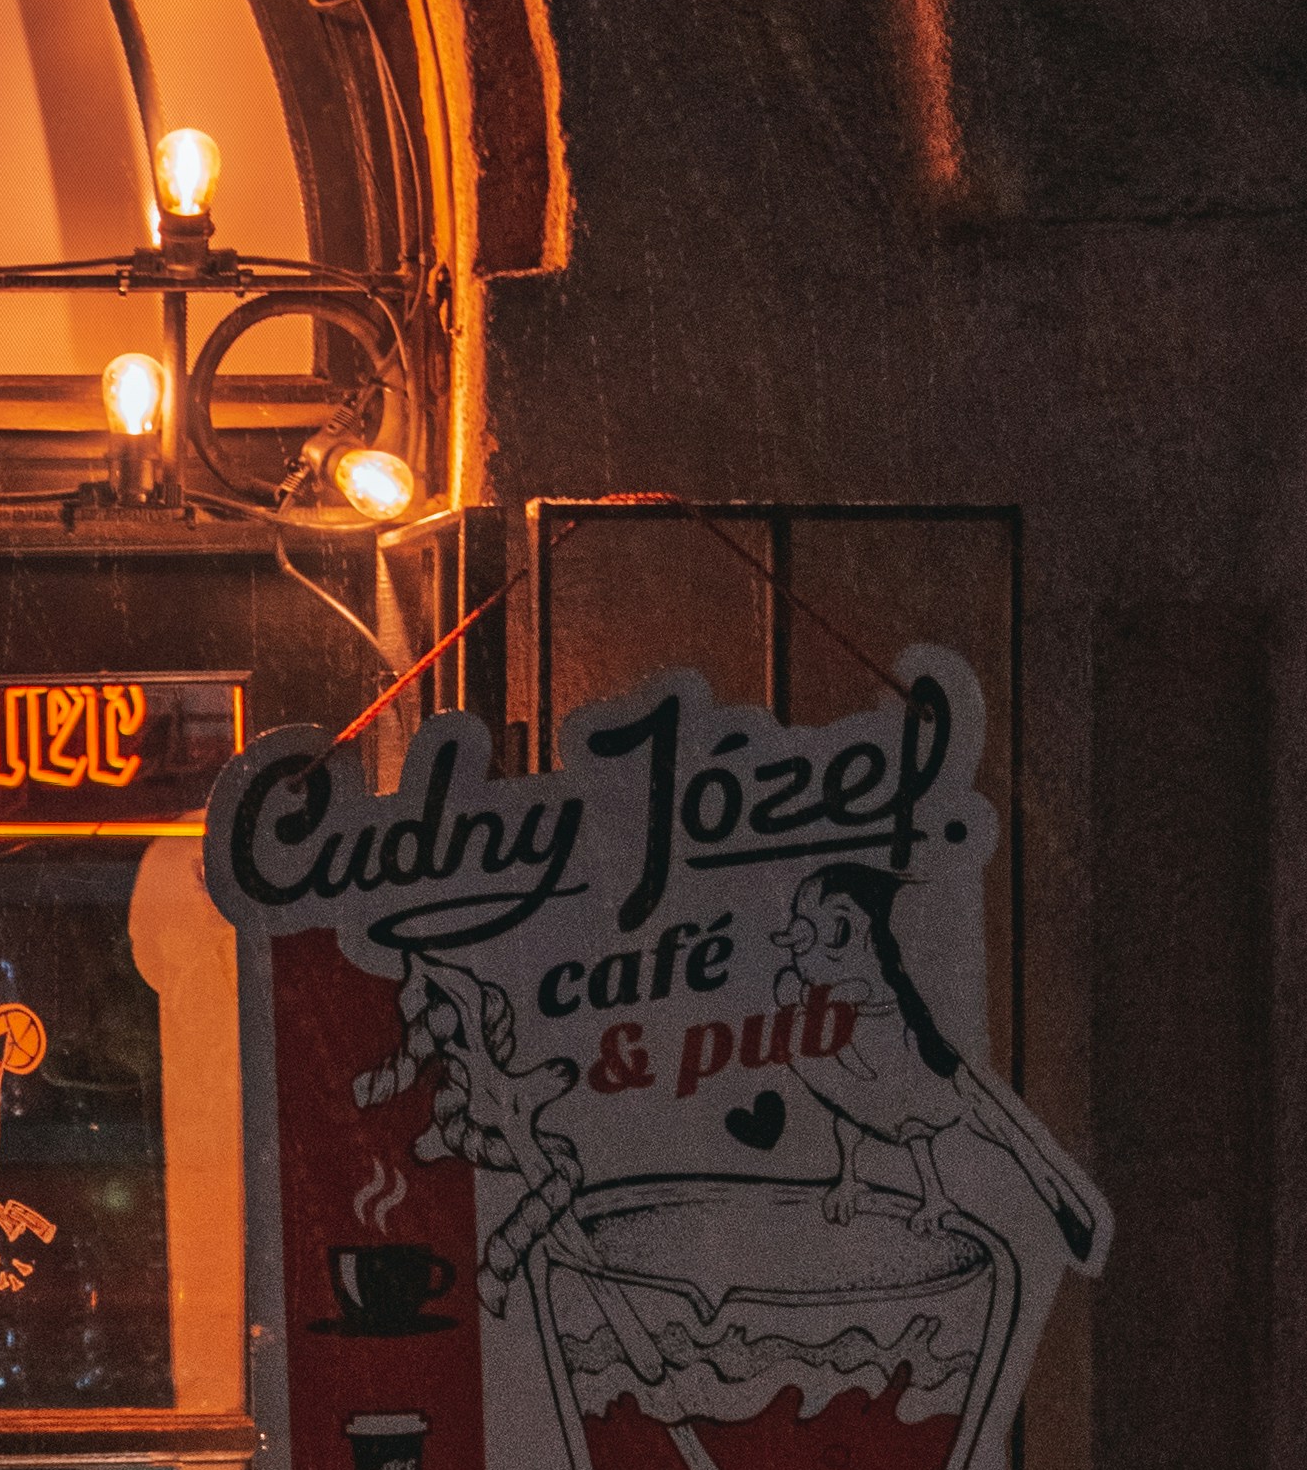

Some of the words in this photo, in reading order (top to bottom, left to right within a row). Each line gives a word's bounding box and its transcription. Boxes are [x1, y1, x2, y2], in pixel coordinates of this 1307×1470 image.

[231, 740, 588, 949] Cudny
[537, 912, 735, 1019] café
[587, 1024, 655, 1095] &
[675, 983, 859, 1099] pub
